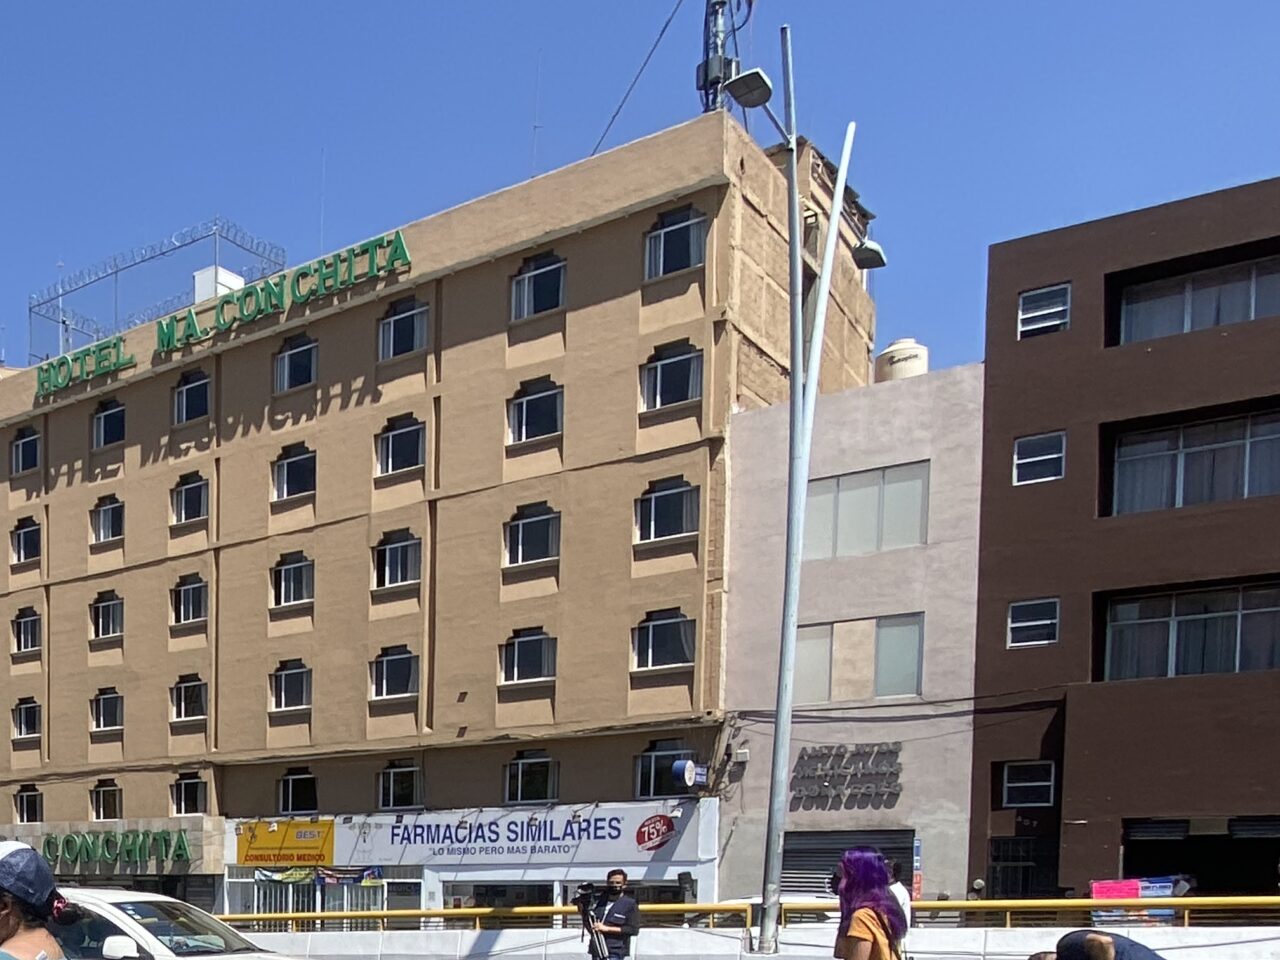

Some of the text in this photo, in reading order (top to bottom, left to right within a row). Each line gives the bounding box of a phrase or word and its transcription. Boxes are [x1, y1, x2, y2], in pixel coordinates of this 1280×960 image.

[36, 230, 412, 396] HOTEL MA. CONCHITA
[390, 816, 622, 846] FARMACIAS SIMILARES
[641, 820, 668, 842] 75%
[41, 829, 192, 865] CONCHITA
[245, 853, 325, 862] CONSULTORIO MEDICO
[446, 847, 477, 857] MISMO
[478, 846, 505, 856] PERO
[506, 846, 529, 856] MAS
